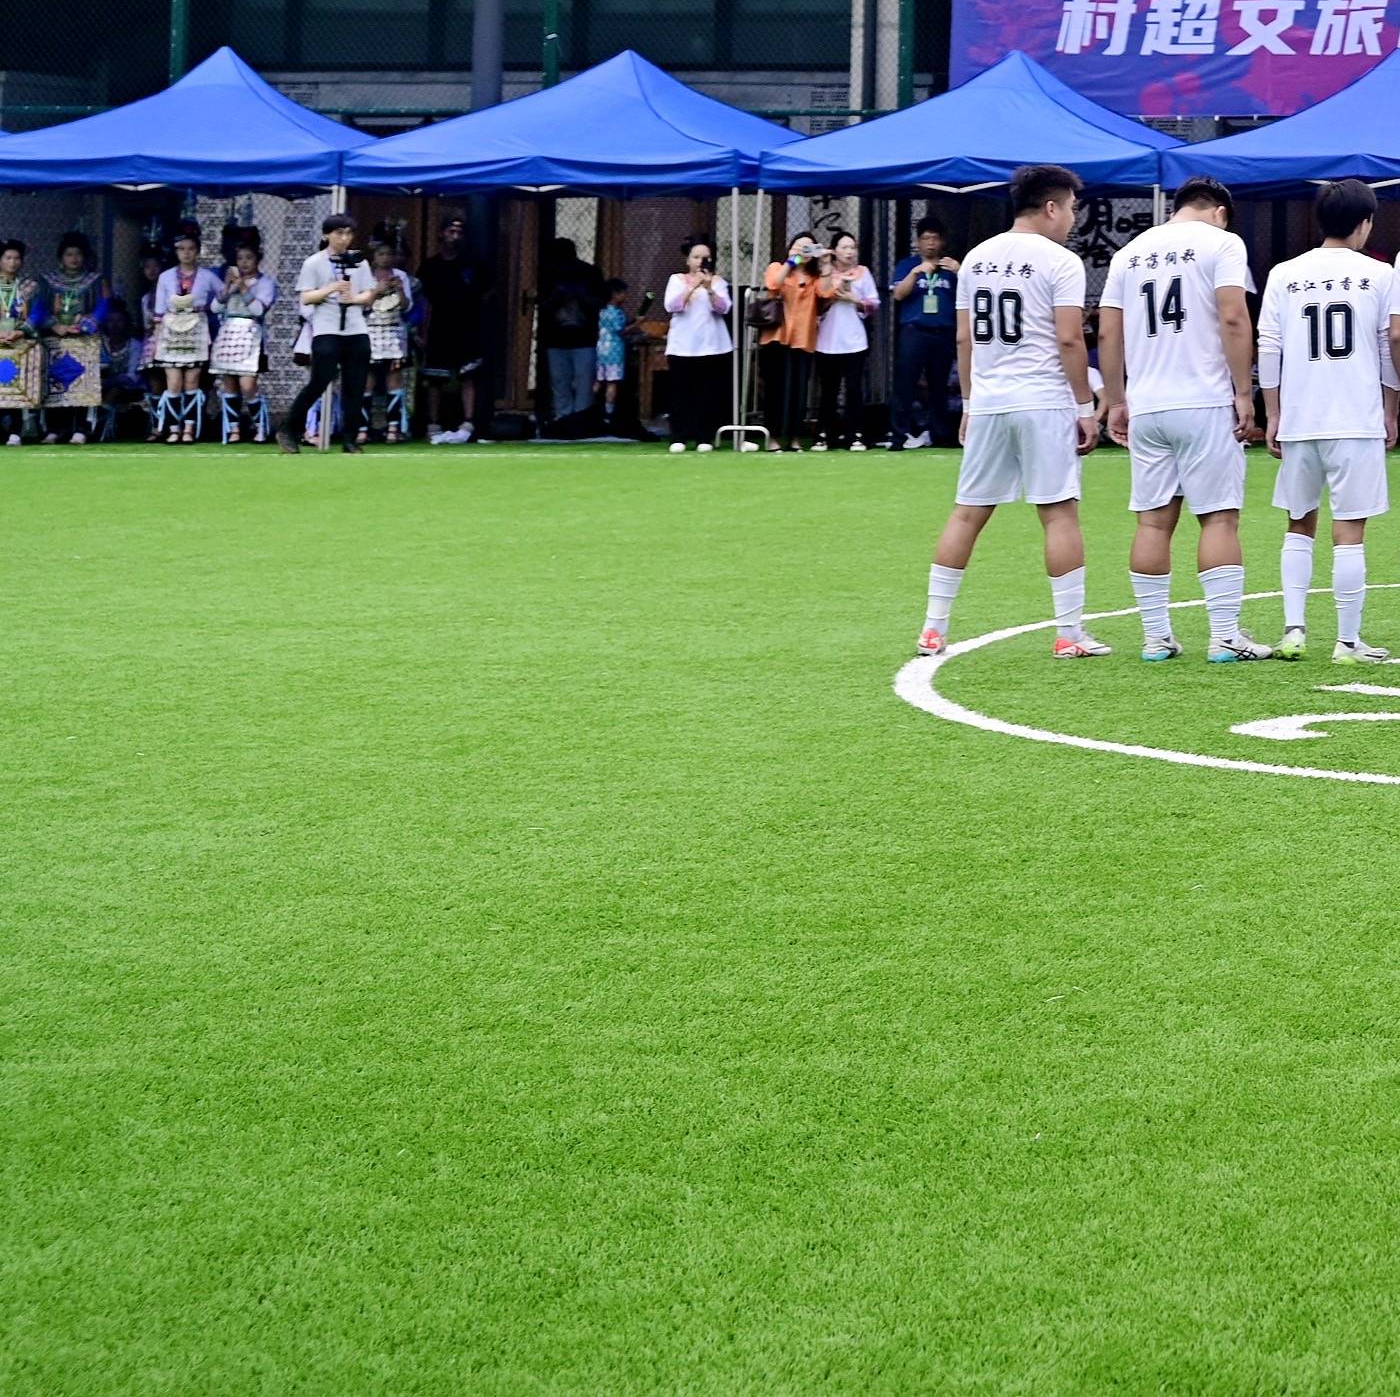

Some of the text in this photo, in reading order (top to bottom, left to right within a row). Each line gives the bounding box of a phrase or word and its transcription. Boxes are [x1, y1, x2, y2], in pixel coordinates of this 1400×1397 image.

[974, 287, 1024, 345] 80
[1140, 275, 1187, 337] 14
[1301, 301, 1355, 361] 10
